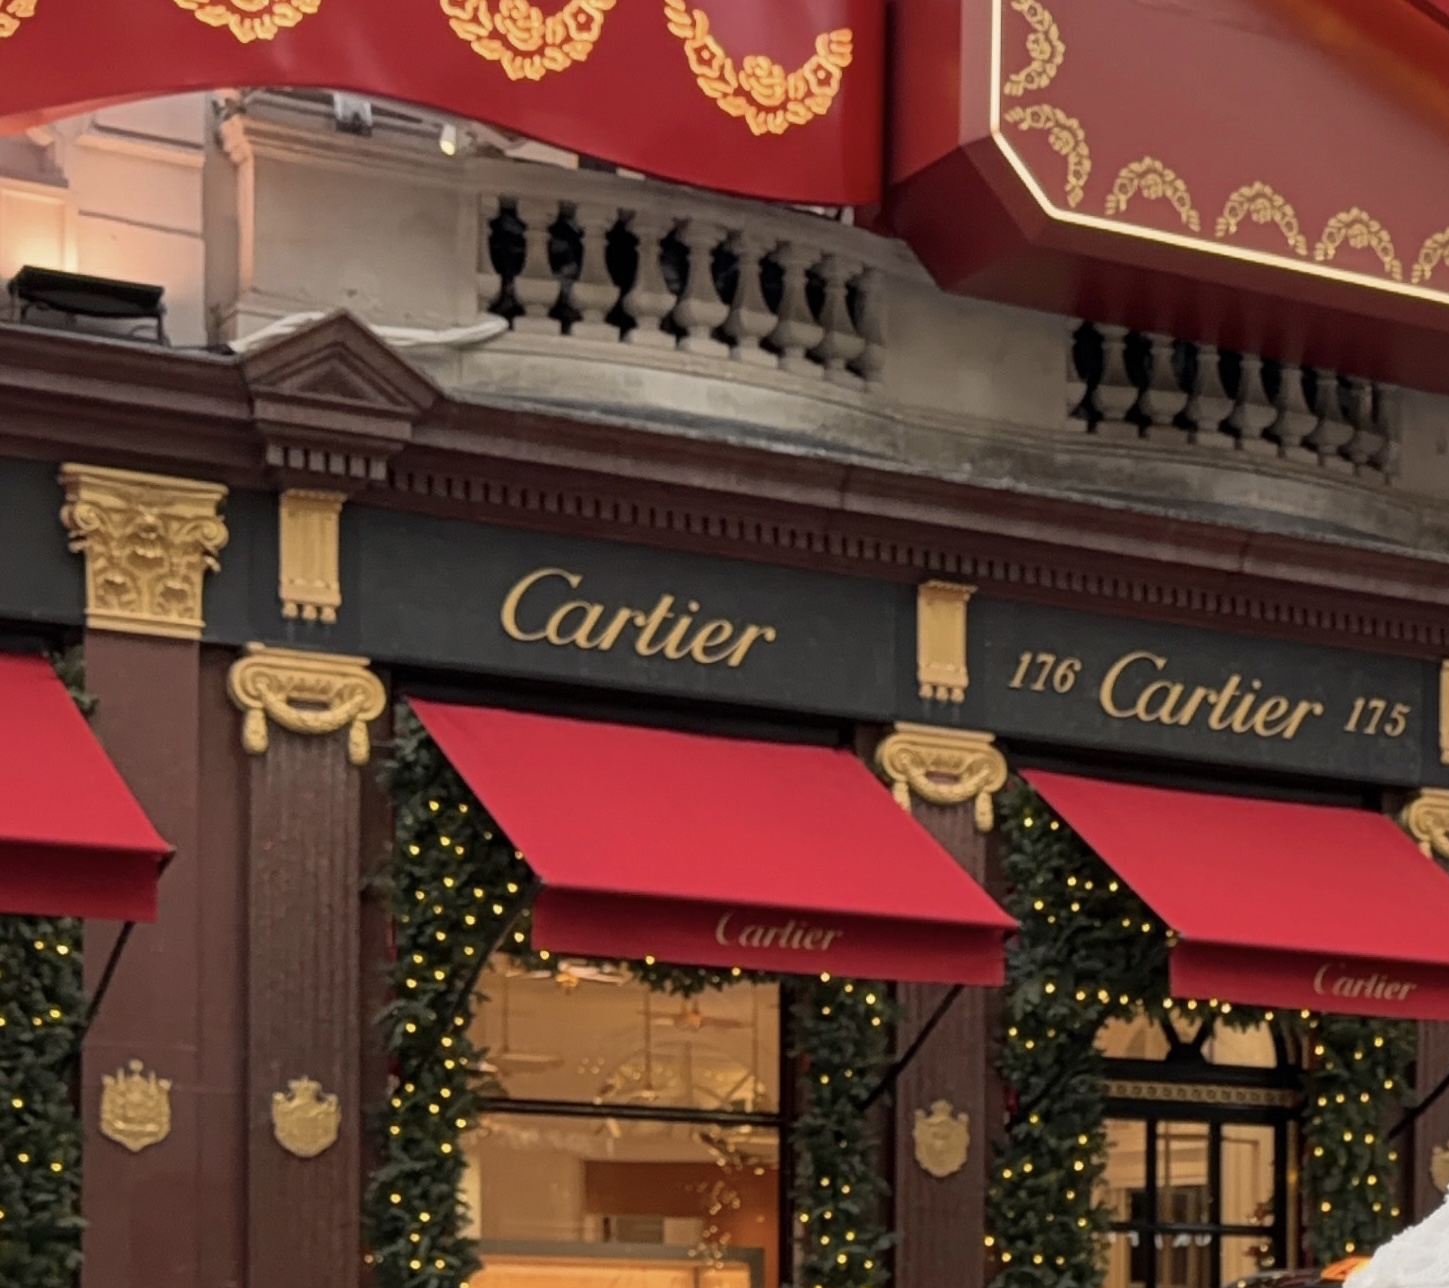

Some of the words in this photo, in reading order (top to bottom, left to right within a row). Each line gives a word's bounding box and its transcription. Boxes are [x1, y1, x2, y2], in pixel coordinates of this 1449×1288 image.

[501, 569, 777, 668] Cartier
[1008, 652, 1081, 693] 176
[1099, 651, 1323, 739] Cartier
[1344, 697, 1410, 737] 175
[714, 912, 843, 953] Cartier
[1312, 962, 1417, 1003] Cartier
